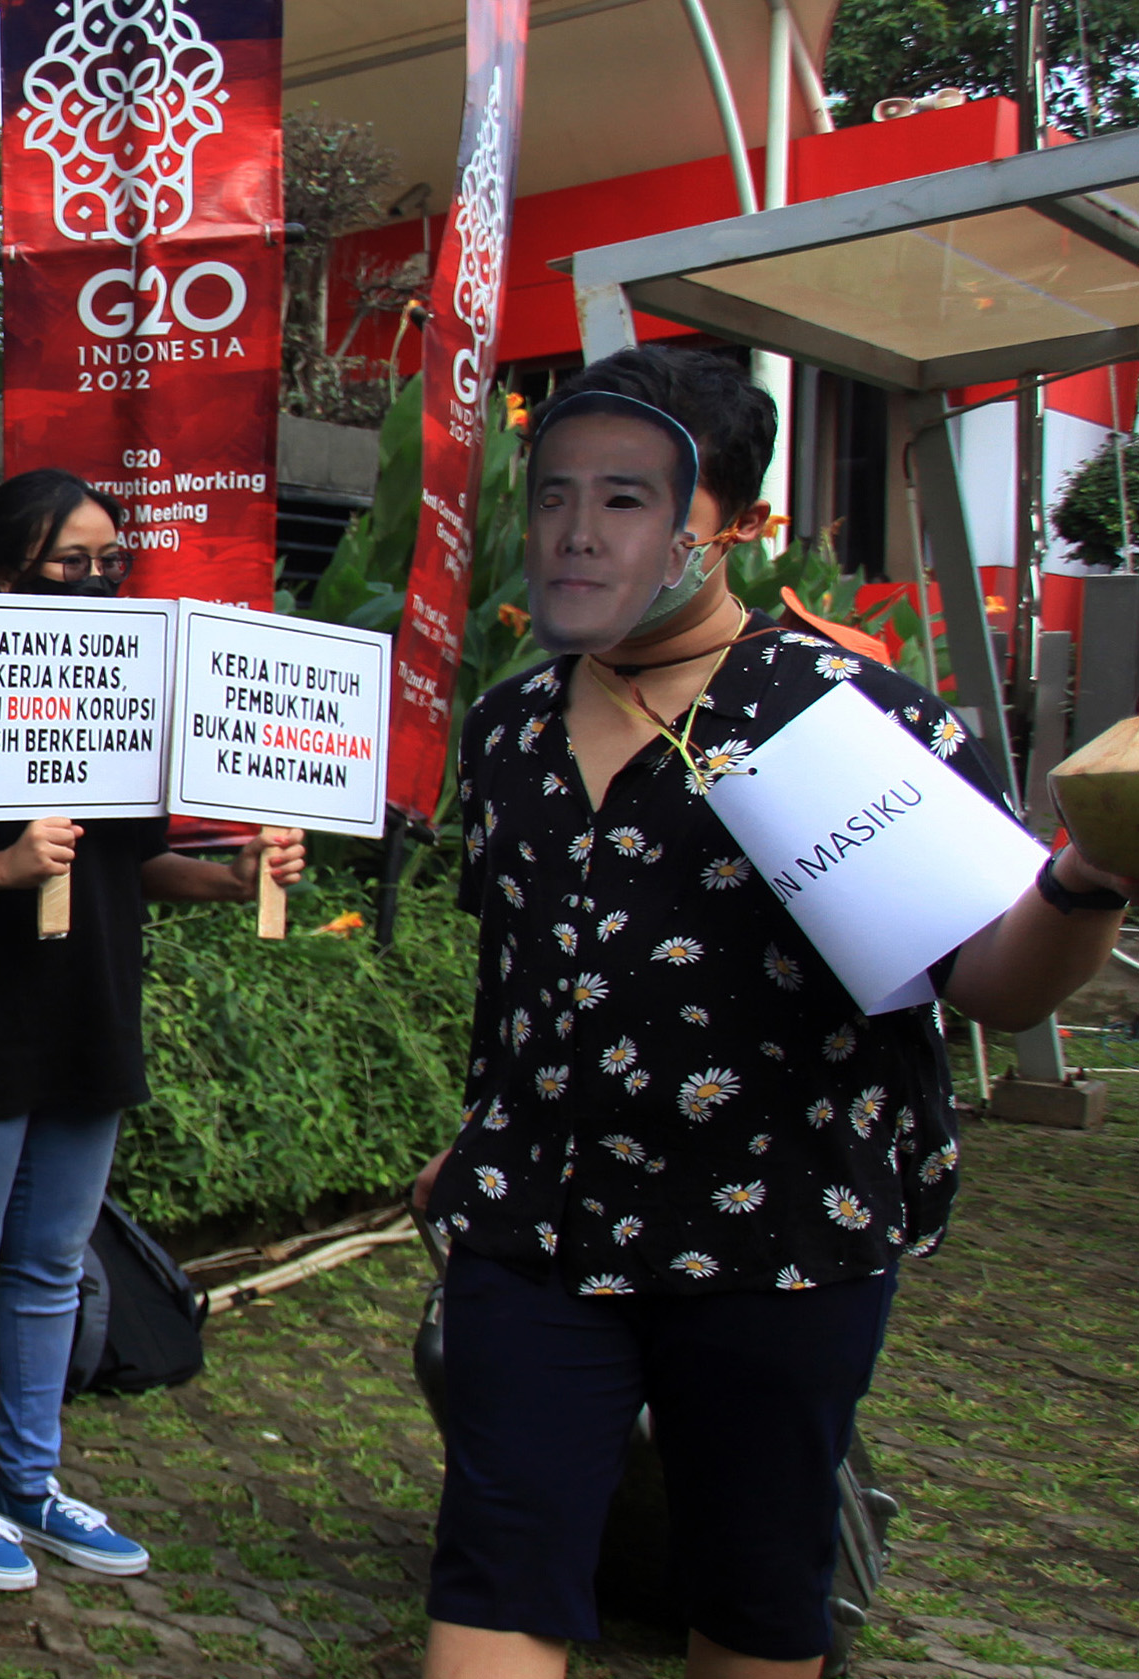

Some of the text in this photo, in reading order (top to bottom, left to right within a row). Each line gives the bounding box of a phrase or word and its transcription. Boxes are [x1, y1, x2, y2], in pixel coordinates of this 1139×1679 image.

[77, 261, 248, 338] G20
[77, 337, 245, 366] INDONESIA
[77, 369, 151, 392] 2022
[122, 449, 161, 468] G20
[174, 471, 266, 494] Working
[135, 502, 208, 524] Meeting
[78, 634, 139, 659] SUDAH
[58, 665, 127, 692] KERAS,
[211, 651, 360, 697] KERJA ITU BUTUH
[7, 696, 71, 721] BURON
[76, 697, 155, 721] KORUPSI
[225, 686, 345, 728] PEMBUKTIAN,
[25, 728, 153, 753] BERKELIARAN
[193, 713, 372, 761] BUKAN SANGGAHAN
[27, 760, 88, 784] BEBAS
[217, 749, 347, 788] KE WARTAWAN
[794, 779, 922, 880] MASIKU
